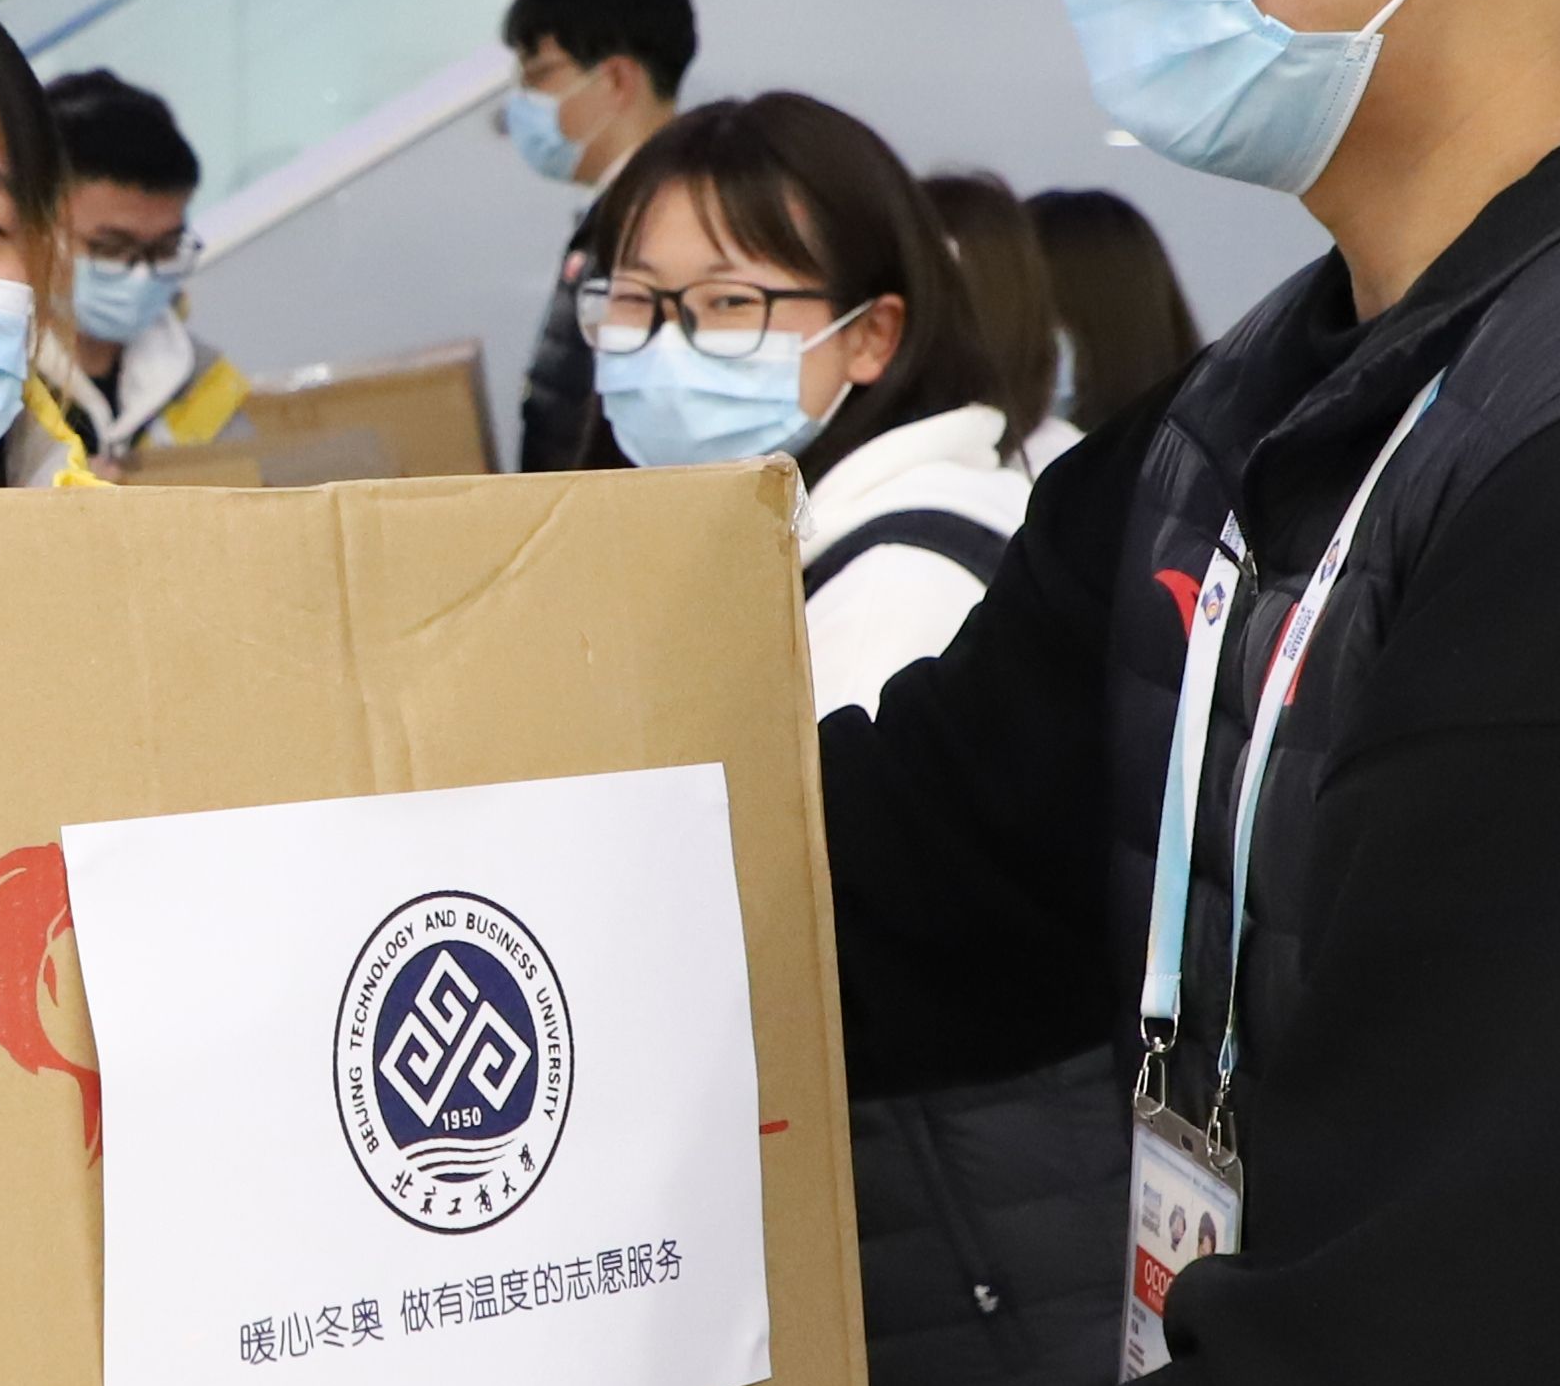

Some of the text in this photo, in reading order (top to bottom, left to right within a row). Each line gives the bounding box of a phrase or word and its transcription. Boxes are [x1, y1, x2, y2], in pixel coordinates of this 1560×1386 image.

[348, 909, 562, 1153] BEIJING TECHNOLOGY AND BUSINESS UNIVERSITY
[441, 1106, 483, 1131] 1950
[239, 1238, 684, 1366] 暖心冬奥 做有温度的志愿服务
